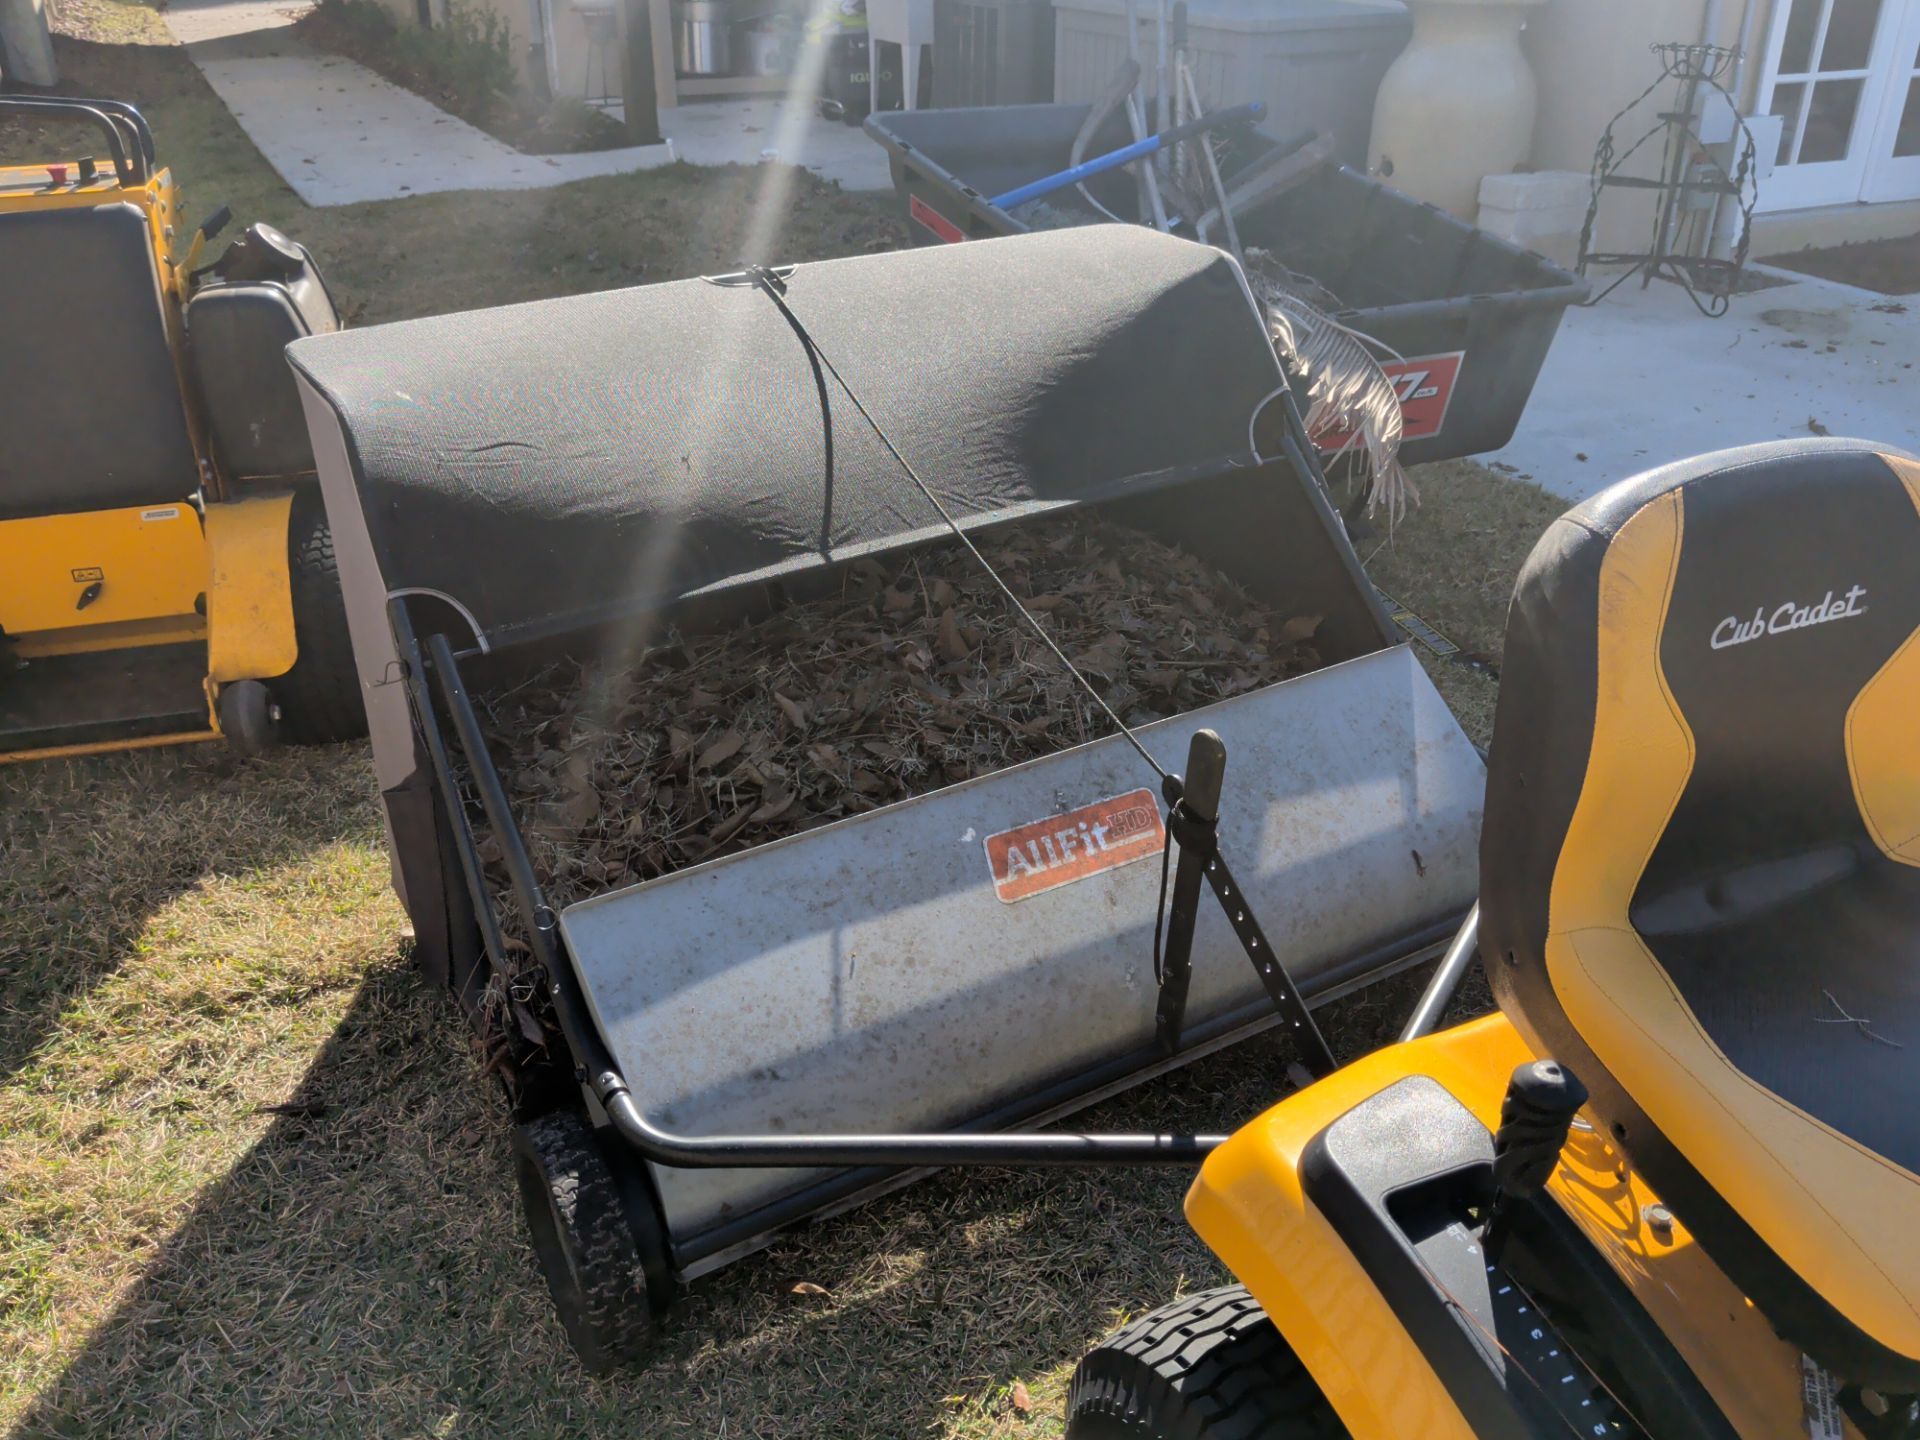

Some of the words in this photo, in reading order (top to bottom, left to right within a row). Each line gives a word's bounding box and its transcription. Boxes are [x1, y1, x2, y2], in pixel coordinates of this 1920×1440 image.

[849, 71, 893, 84] IGLO
[1710, 606, 1766, 650] Cub
[1767, 585, 1867, 635] Cadet
[1005, 821, 1109, 881] AllFit
[1106, 806, 1152, 838] HD
[1530, 1327, 1543, 1340] 3
[1593, 1422, 1607, 1436] 2
